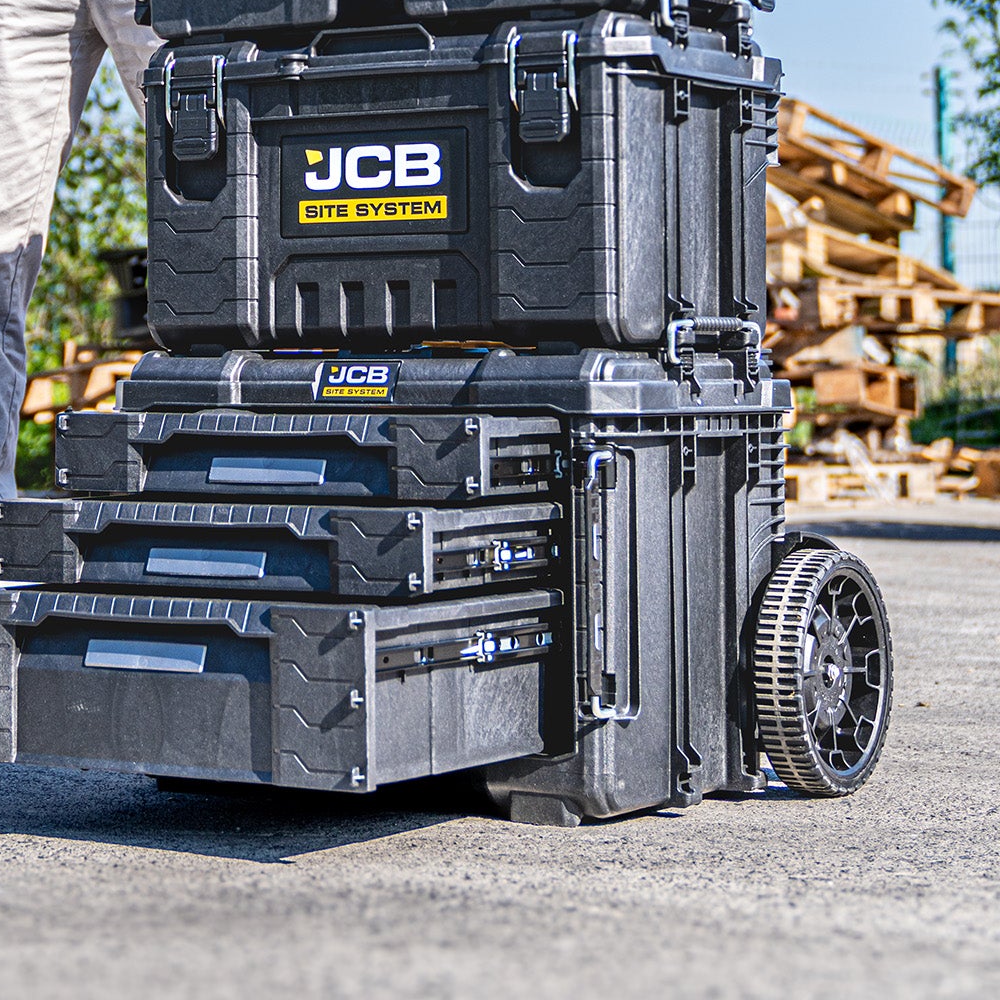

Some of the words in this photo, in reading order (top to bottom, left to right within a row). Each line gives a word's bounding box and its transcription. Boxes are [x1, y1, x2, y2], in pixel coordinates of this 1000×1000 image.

[305, 143, 442, 190] JCB
[305, 204, 348, 218] SITE
[355, 200, 441, 217] SYSTEM
[328, 366, 389, 384] JCB
